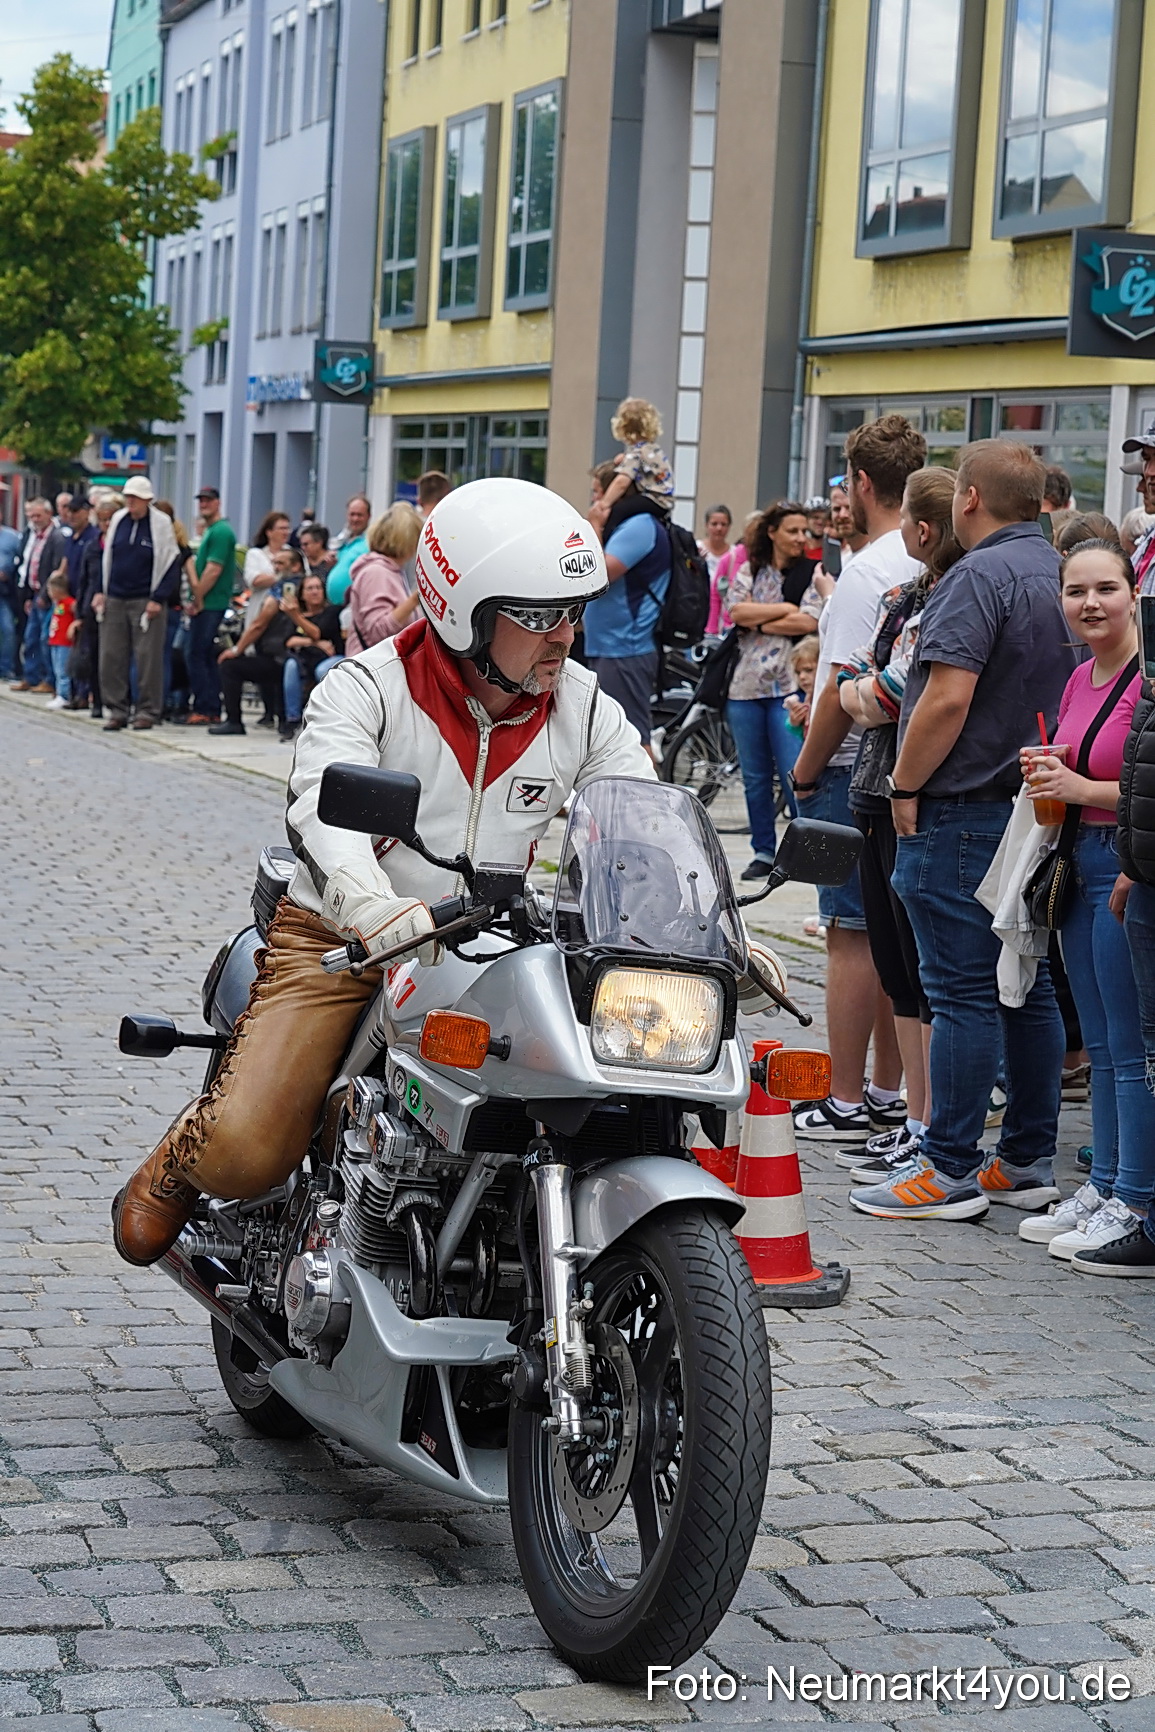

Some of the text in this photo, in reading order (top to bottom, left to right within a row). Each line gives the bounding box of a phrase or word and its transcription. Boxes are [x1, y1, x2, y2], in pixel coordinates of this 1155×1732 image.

[1119, 266, 1155, 317] G2
[425, 519, 460, 588] aytona
[564, 553, 595, 575] NOLAN
